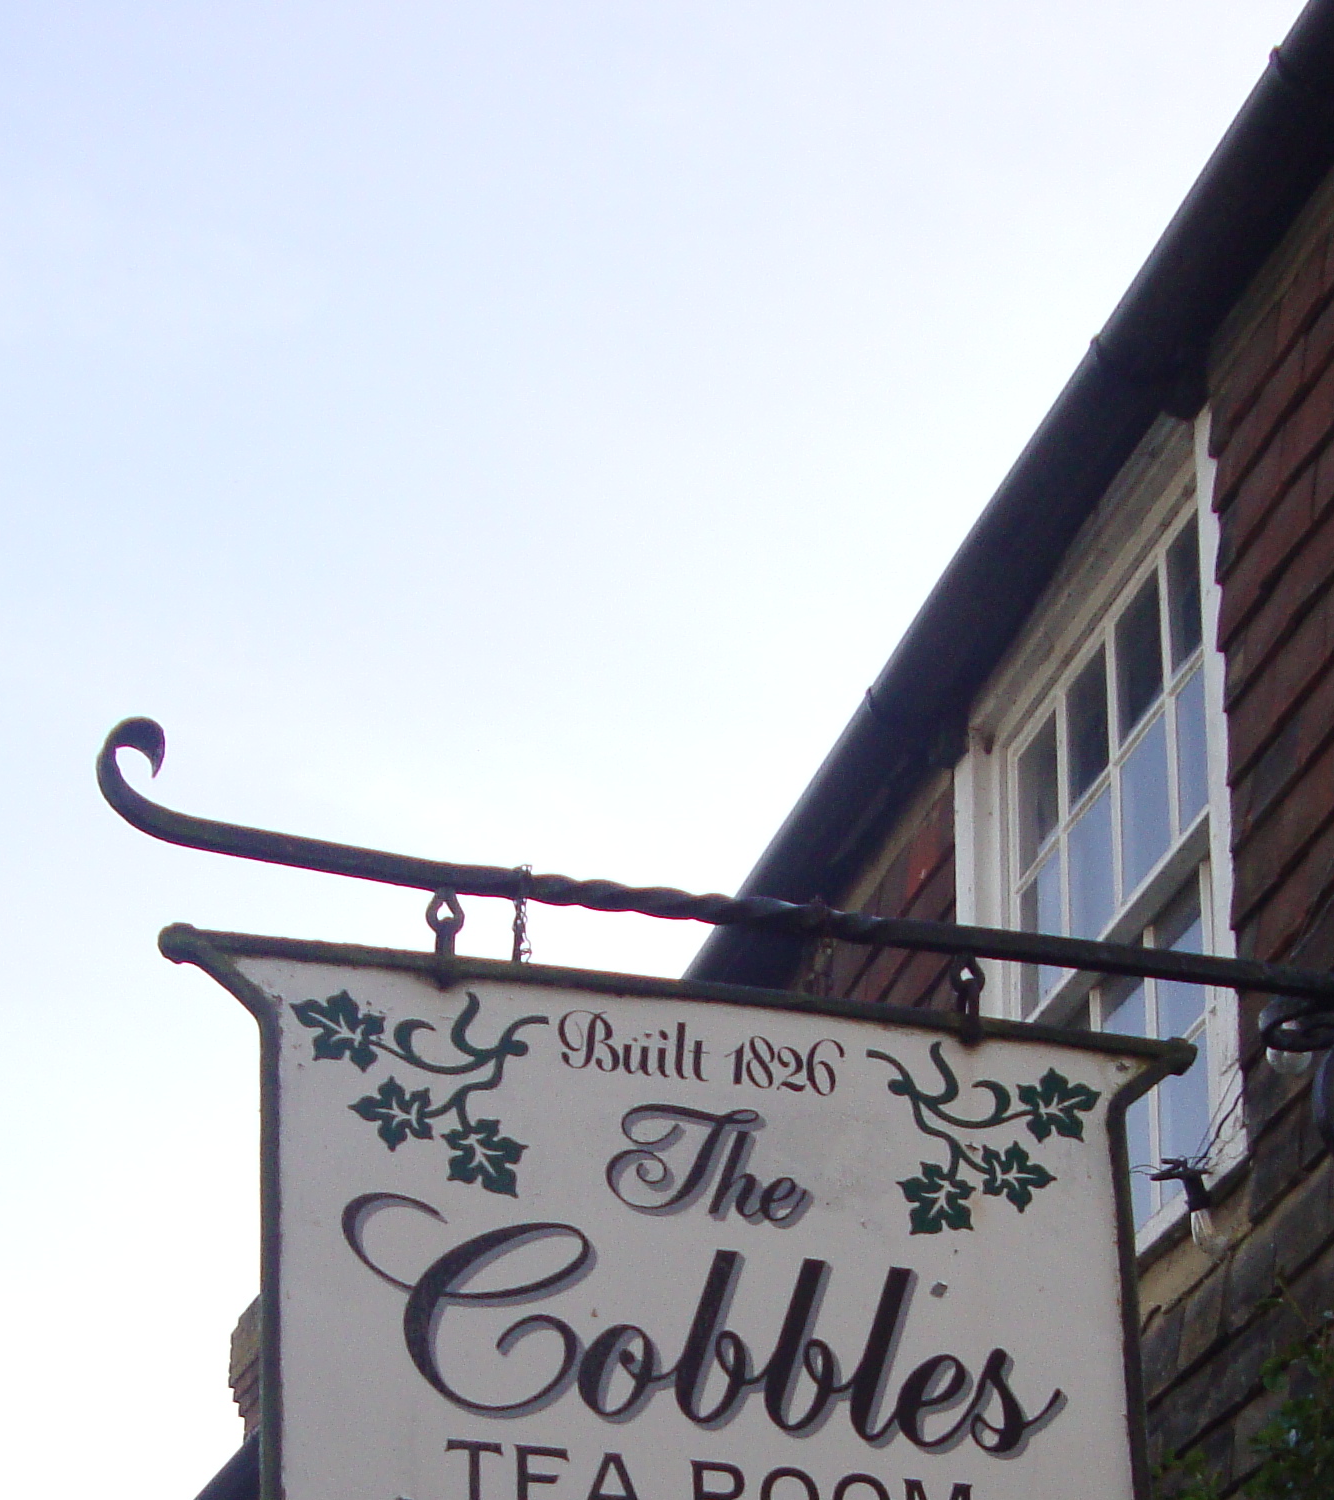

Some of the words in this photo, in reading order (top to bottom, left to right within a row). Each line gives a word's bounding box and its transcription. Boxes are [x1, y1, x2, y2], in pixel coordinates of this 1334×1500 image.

[724, 1035, 845, 1096] 1826
[606, 1104, 812, 1229] The
[341, 1192, 1067, 1459] Cobbles
